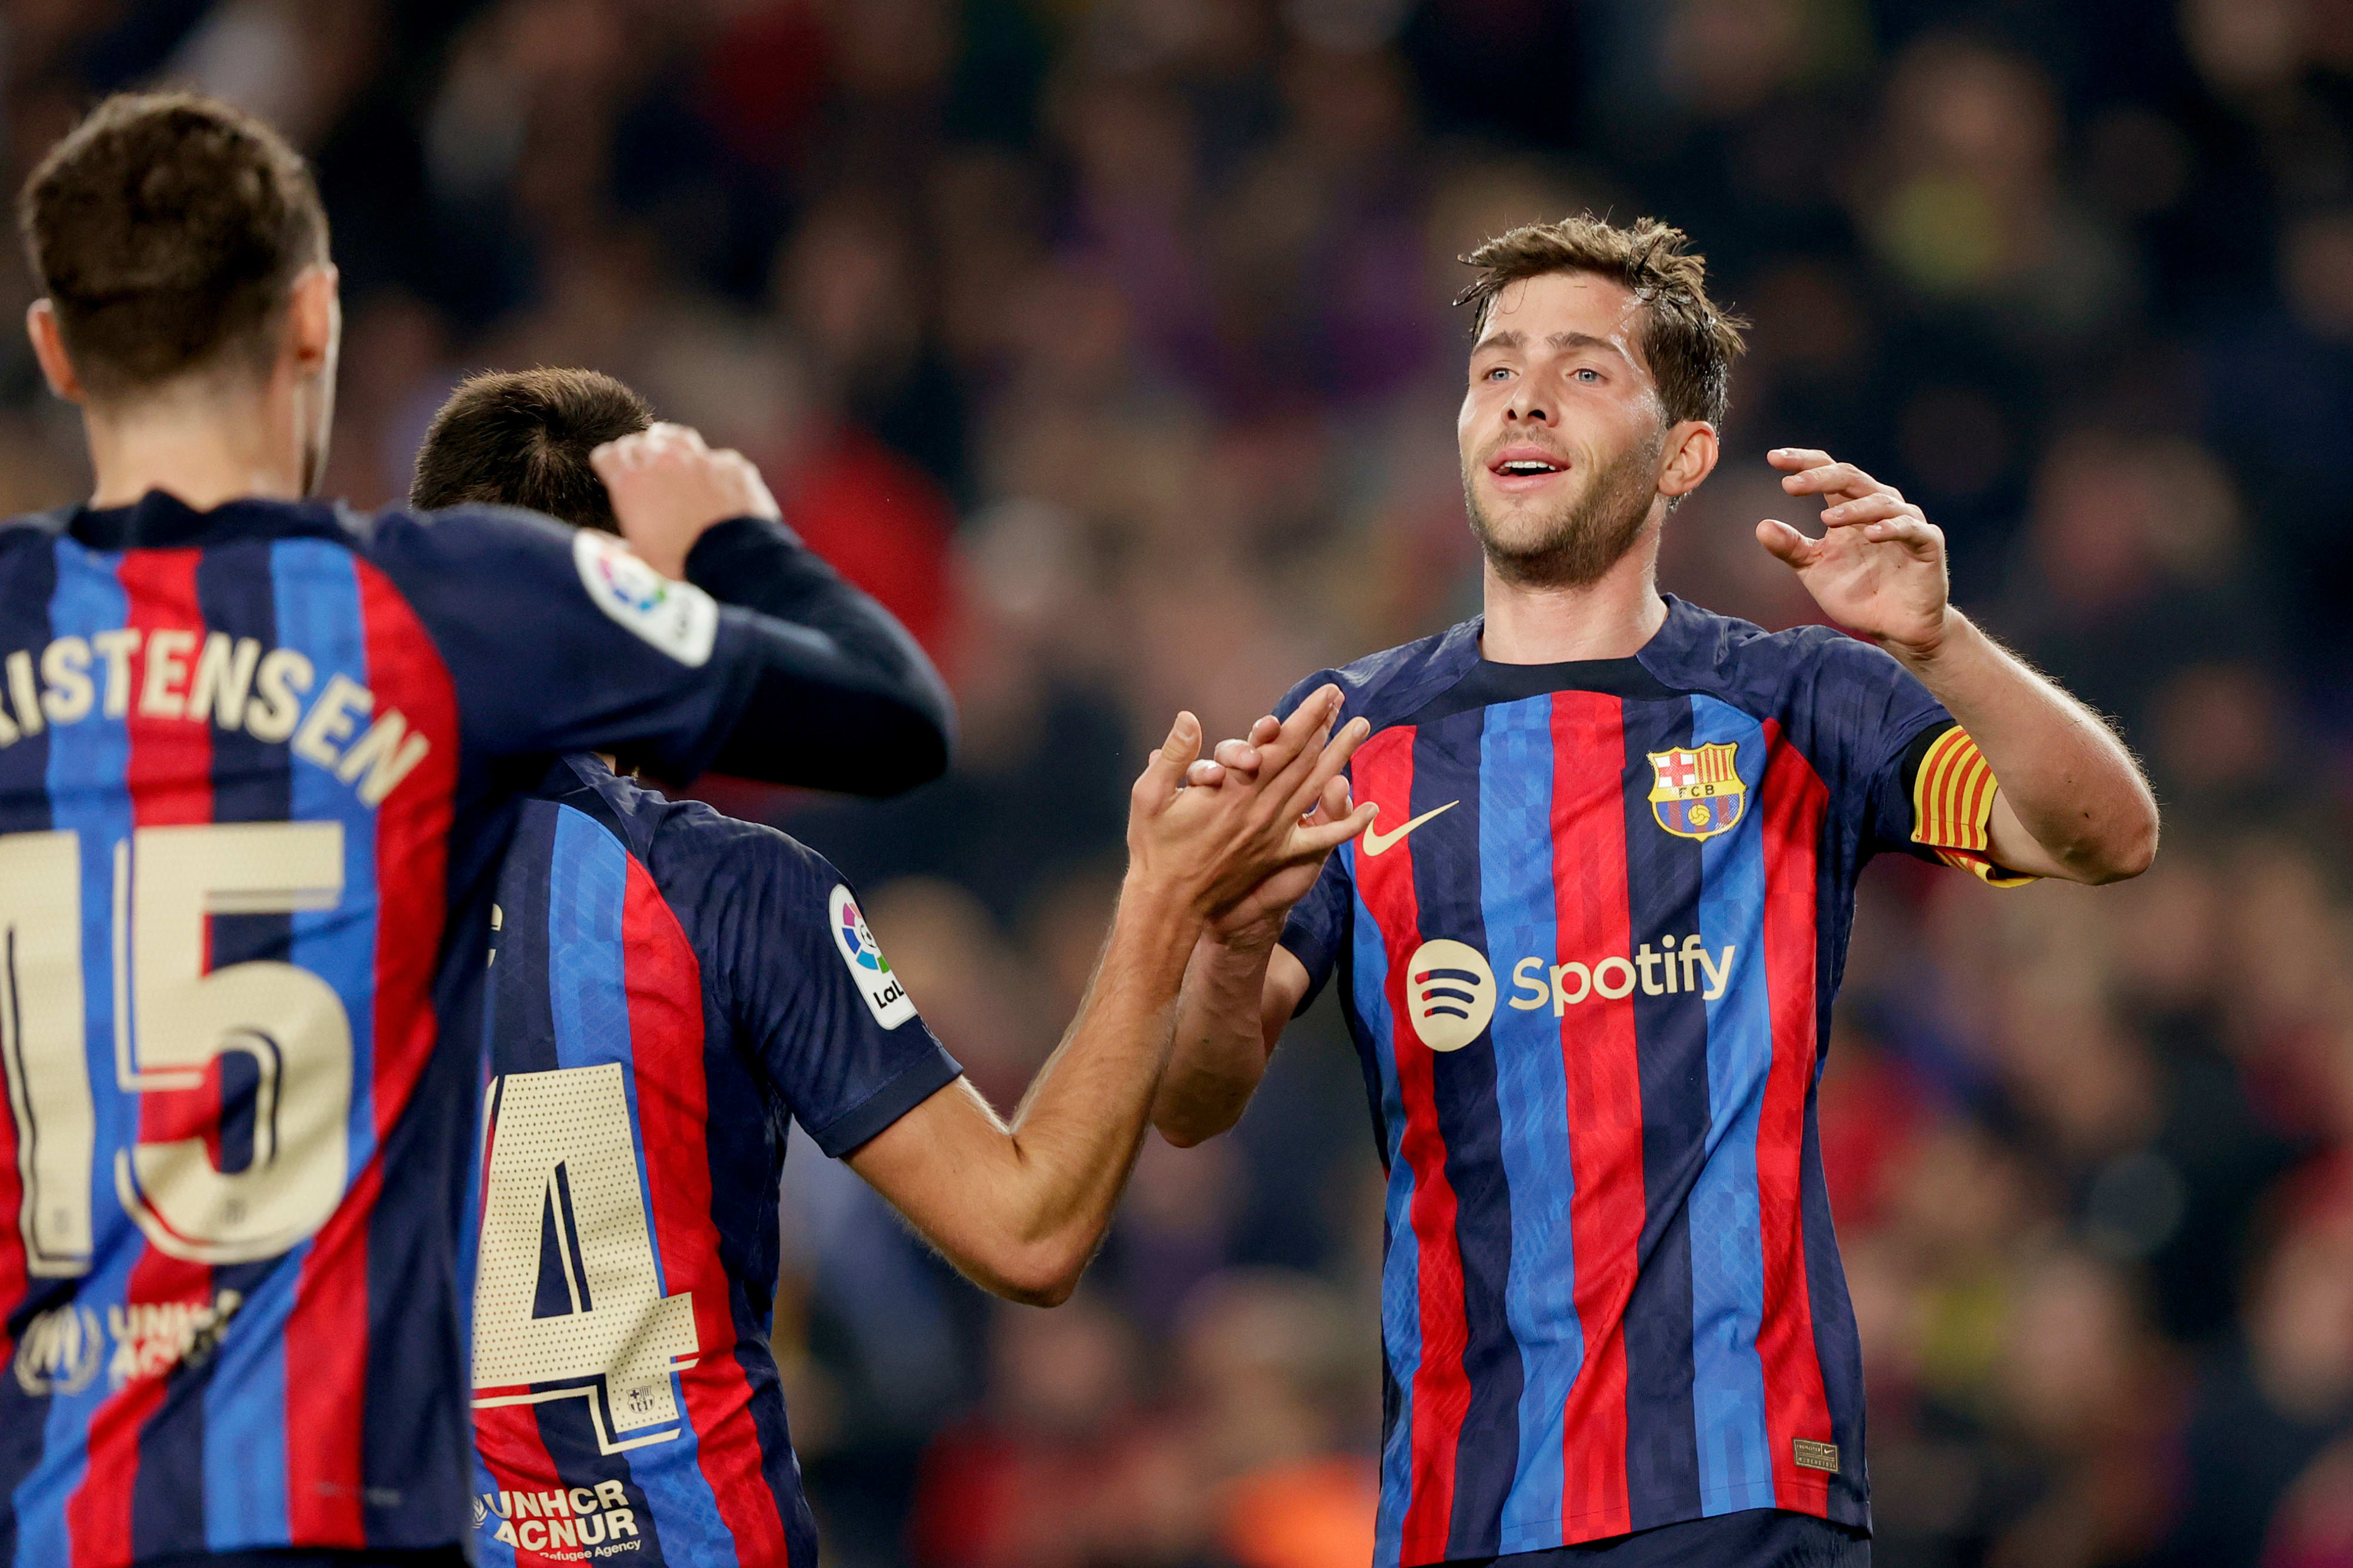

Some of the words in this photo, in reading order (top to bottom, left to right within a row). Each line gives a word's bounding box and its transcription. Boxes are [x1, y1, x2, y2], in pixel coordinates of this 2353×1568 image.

[1679, 785, 1714, 798] FCB
[1508, 933, 1736, 1018] Spotify
[0, 821, 354, 1278] 15
[471, 1062, 700, 1456] 4
[482, 1479, 629, 1519] UNHCR
[493, 1507, 639, 1552] ACNUR
[594, 1539, 642, 1558] Agency
